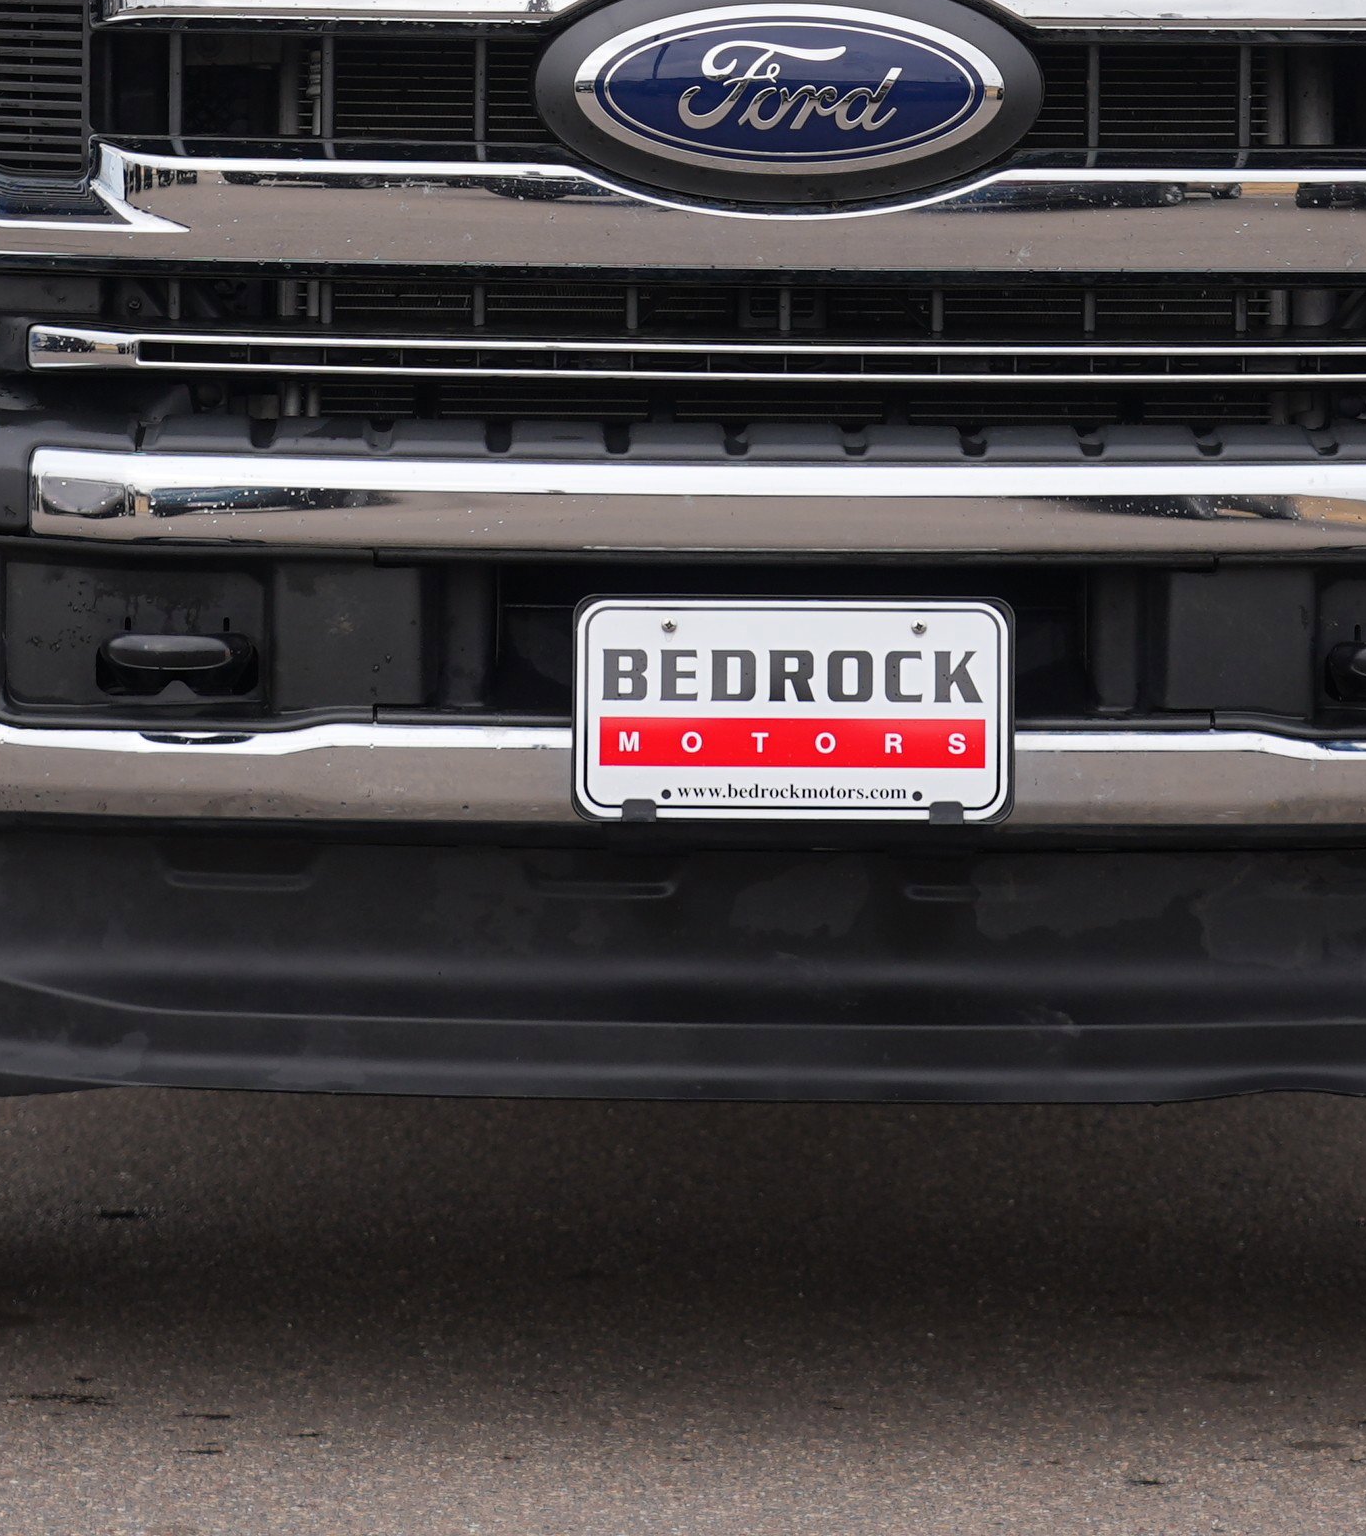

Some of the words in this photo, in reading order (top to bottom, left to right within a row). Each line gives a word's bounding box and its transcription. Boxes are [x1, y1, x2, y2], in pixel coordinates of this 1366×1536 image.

[677, 39, 903, 131] Ford
[600, 648, 984, 704] BEDROCK
[617, 730, 967, 755] MOTORS
[677, 783, 907, 800] www.bedrockmotors.com
